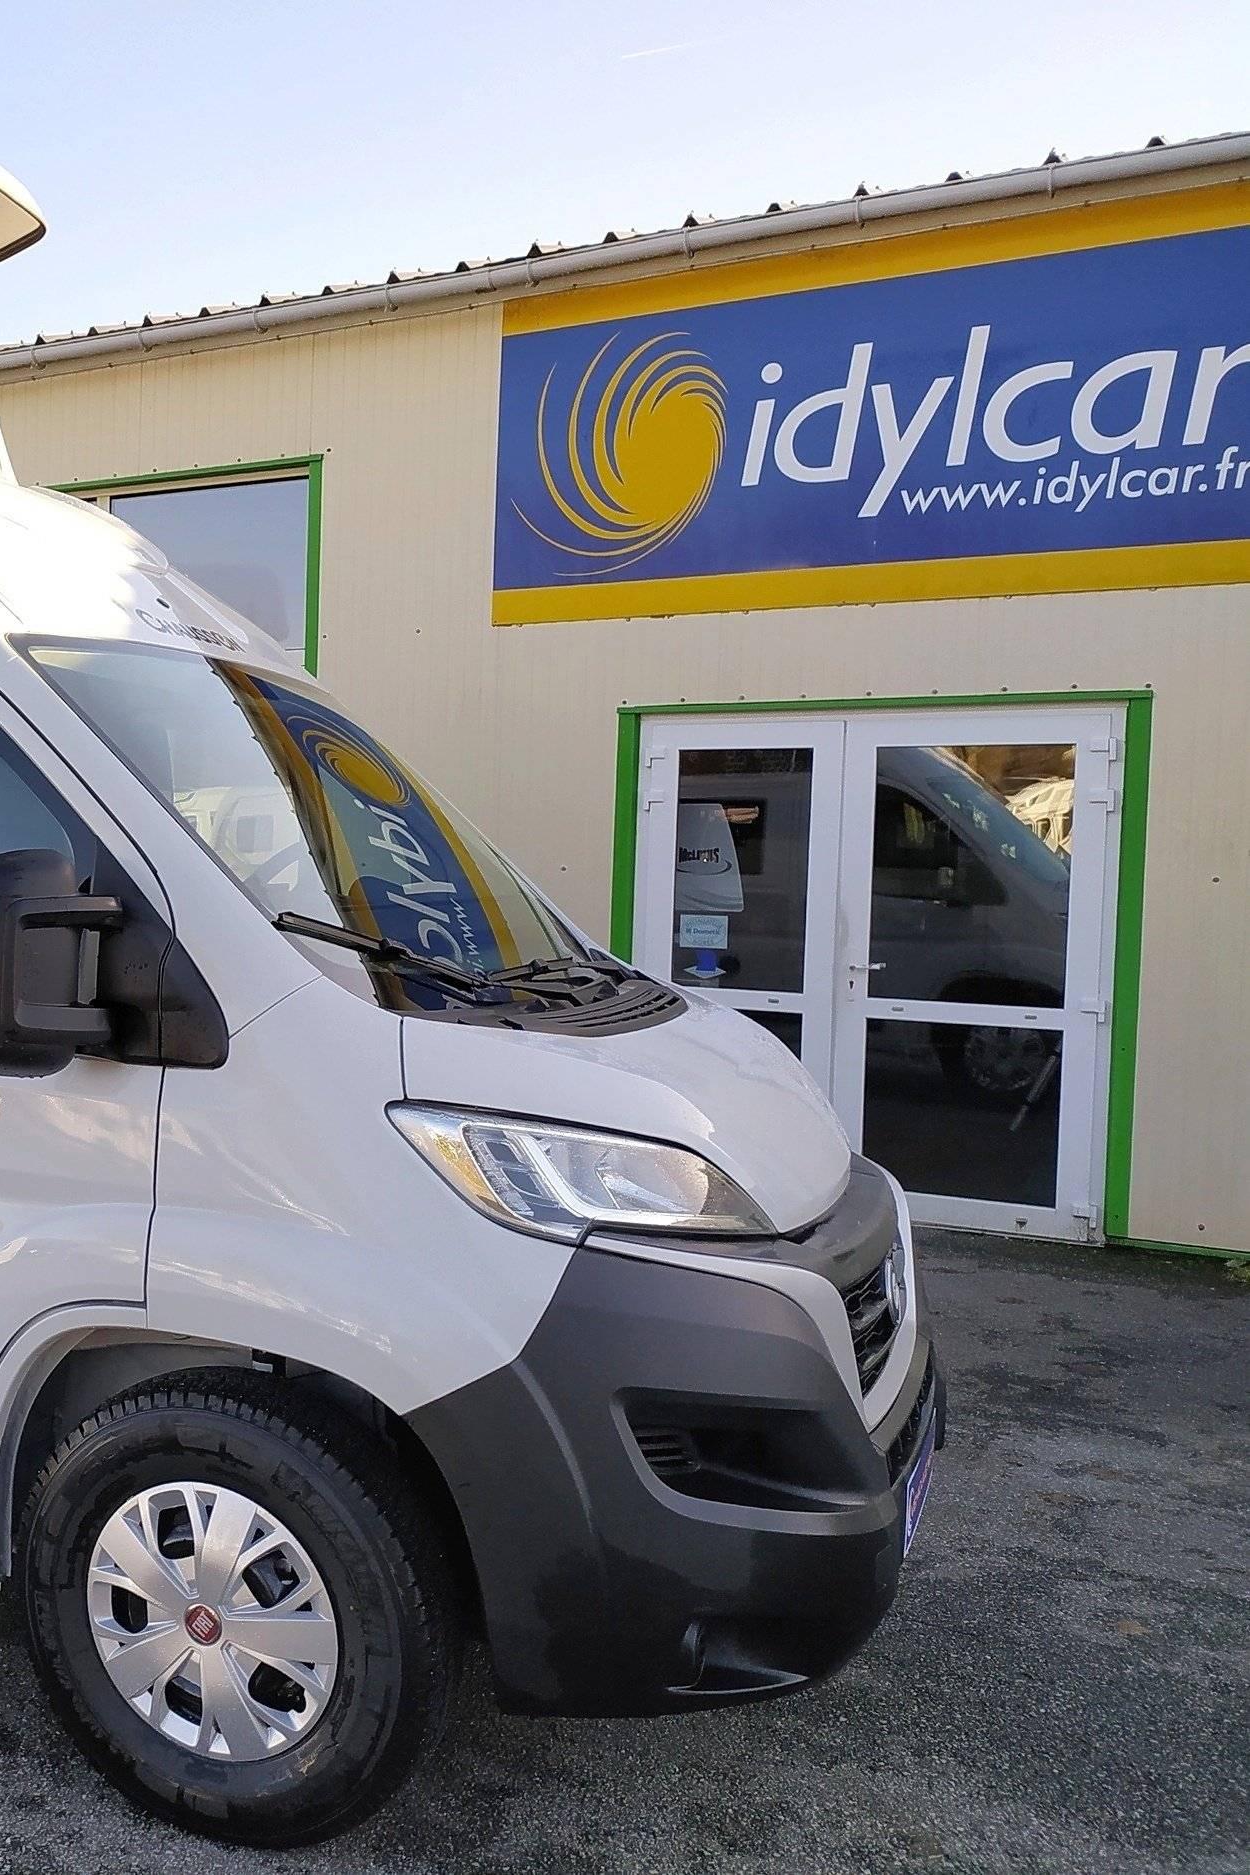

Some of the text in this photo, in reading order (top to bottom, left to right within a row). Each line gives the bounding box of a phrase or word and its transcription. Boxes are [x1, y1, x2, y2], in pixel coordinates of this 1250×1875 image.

[741, 325, 1250, 518] idylcar
[901, 446, 1250, 515] www.idylcar.fr
[191, 1610, 215, 1638] FIAT
